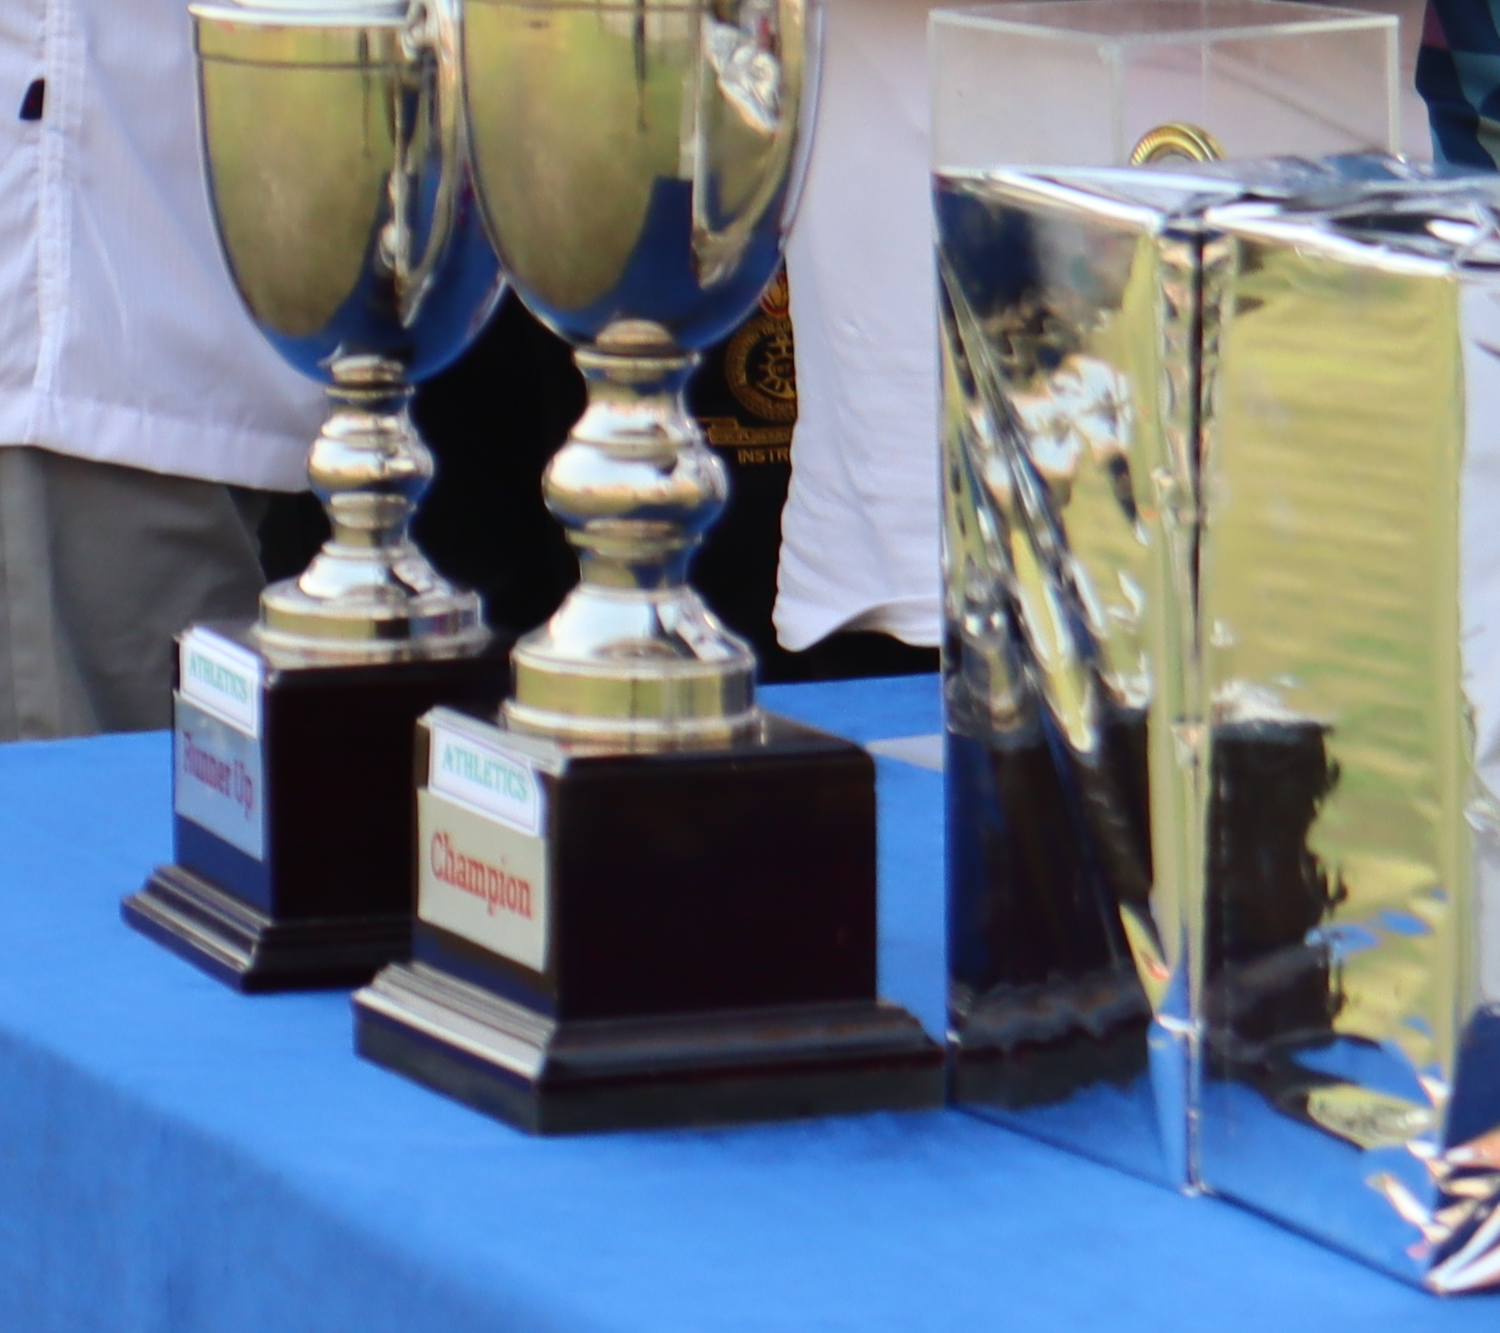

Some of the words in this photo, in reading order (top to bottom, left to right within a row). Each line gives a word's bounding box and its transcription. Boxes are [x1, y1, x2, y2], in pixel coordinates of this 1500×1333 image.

[738, 447, 789, 464] INSTR
[442, 743, 528, 802] ATHLETICS
[430, 831, 533, 921] Champion
